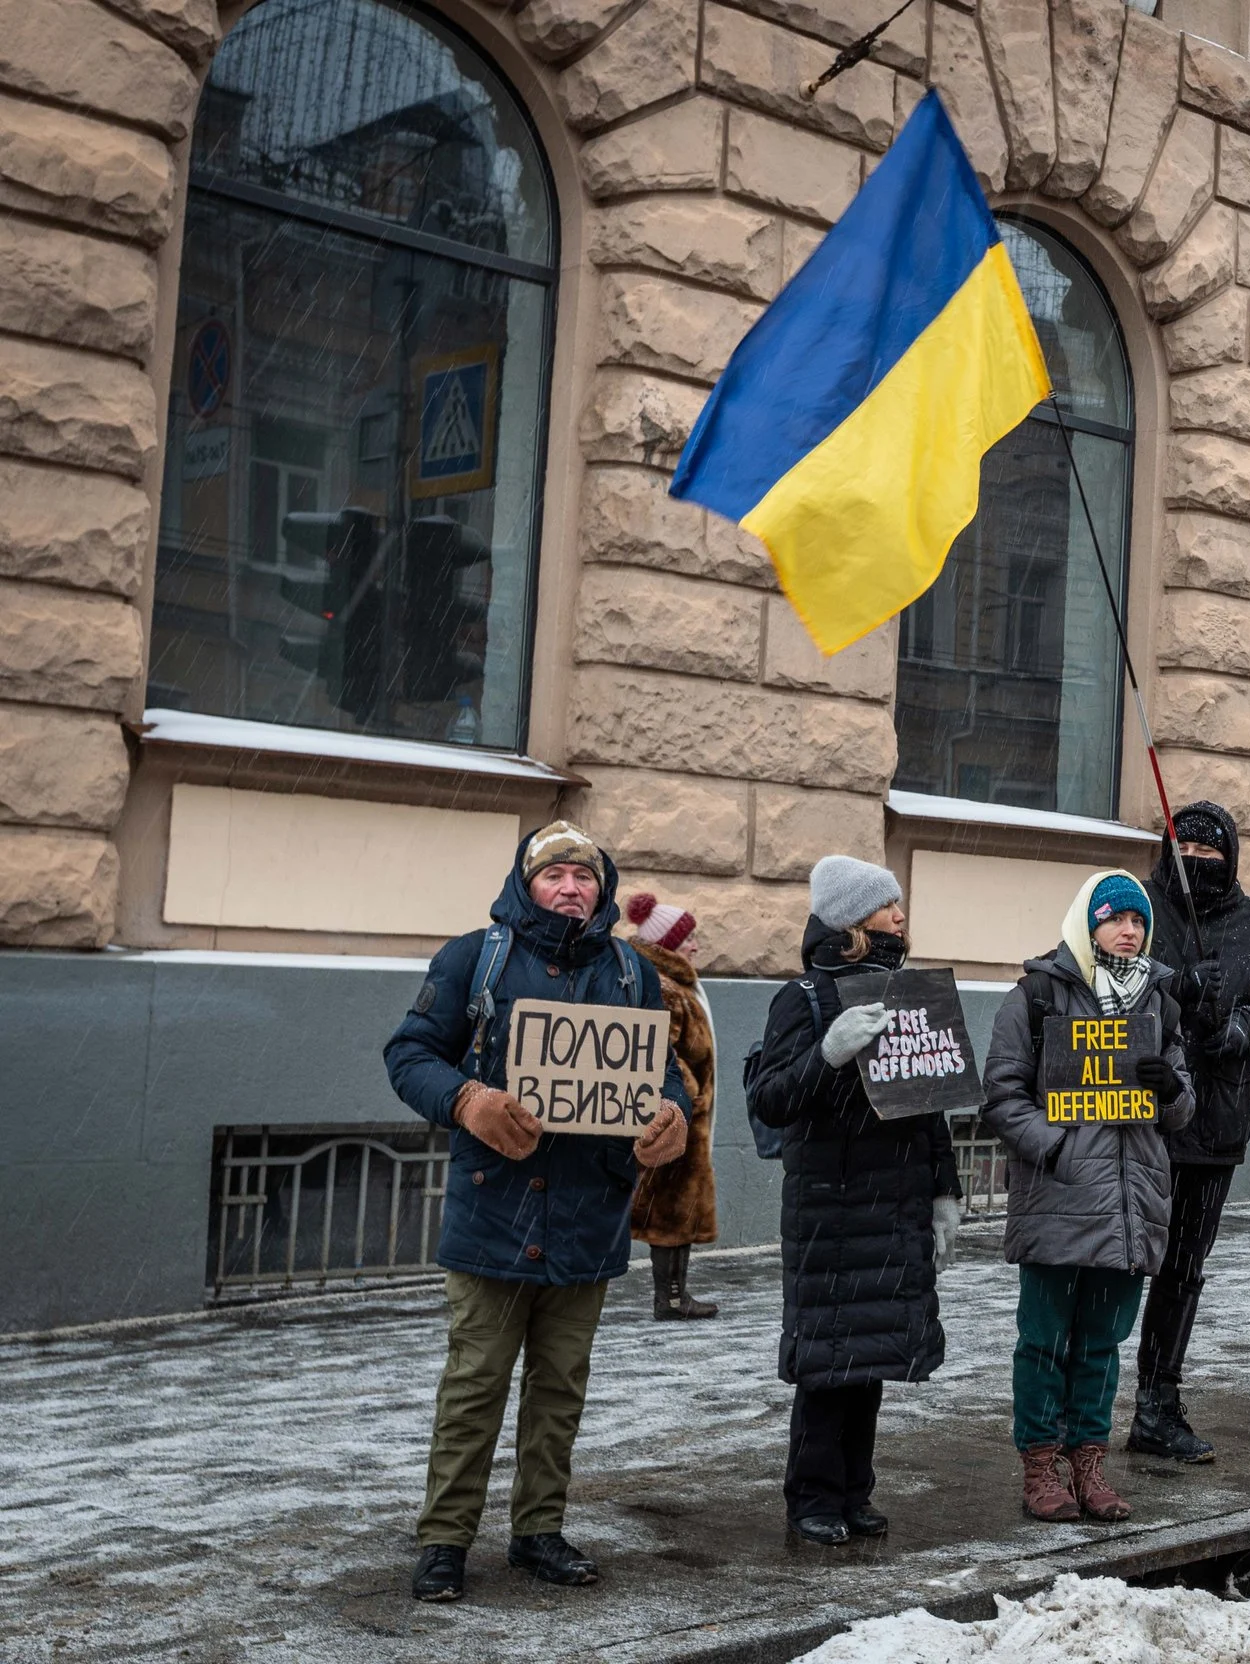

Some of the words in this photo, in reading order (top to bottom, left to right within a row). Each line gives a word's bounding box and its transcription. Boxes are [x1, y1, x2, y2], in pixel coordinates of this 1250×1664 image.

[887, 1008, 930, 1034] FREE
[1071, 1019, 1128, 1051] FREE
[515, 1011, 656, 1072] ПОЛОН
[878, 1028, 960, 1058] AZOVSTAL
[869, 1050, 966, 1082] DEFENDERS
[1081, 1055, 1122, 1085] ALL
[518, 1076, 656, 1126] ВБИВАЄ
[1047, 1089, 1155, 1122] DEFENDERS
